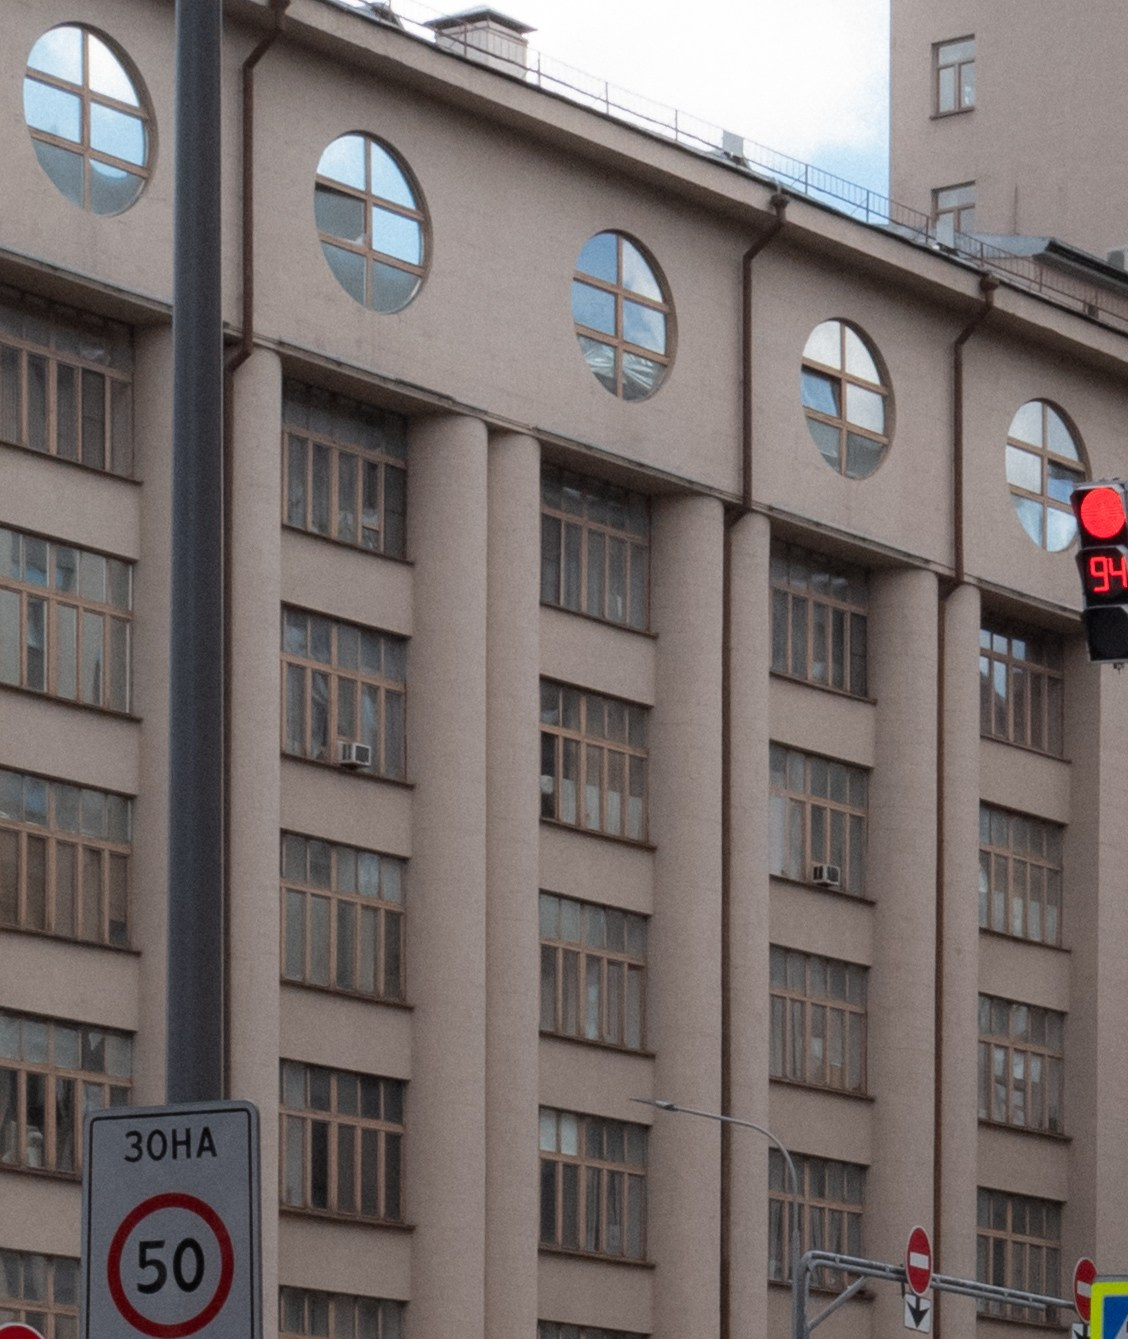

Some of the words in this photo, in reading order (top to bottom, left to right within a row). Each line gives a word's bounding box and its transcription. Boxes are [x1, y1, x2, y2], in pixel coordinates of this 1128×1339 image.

[1089, 556, 1128, 592] 94
[124, 1126, 218, 1162] ЗОНА
[137, 1237, 205, 1294] 50
